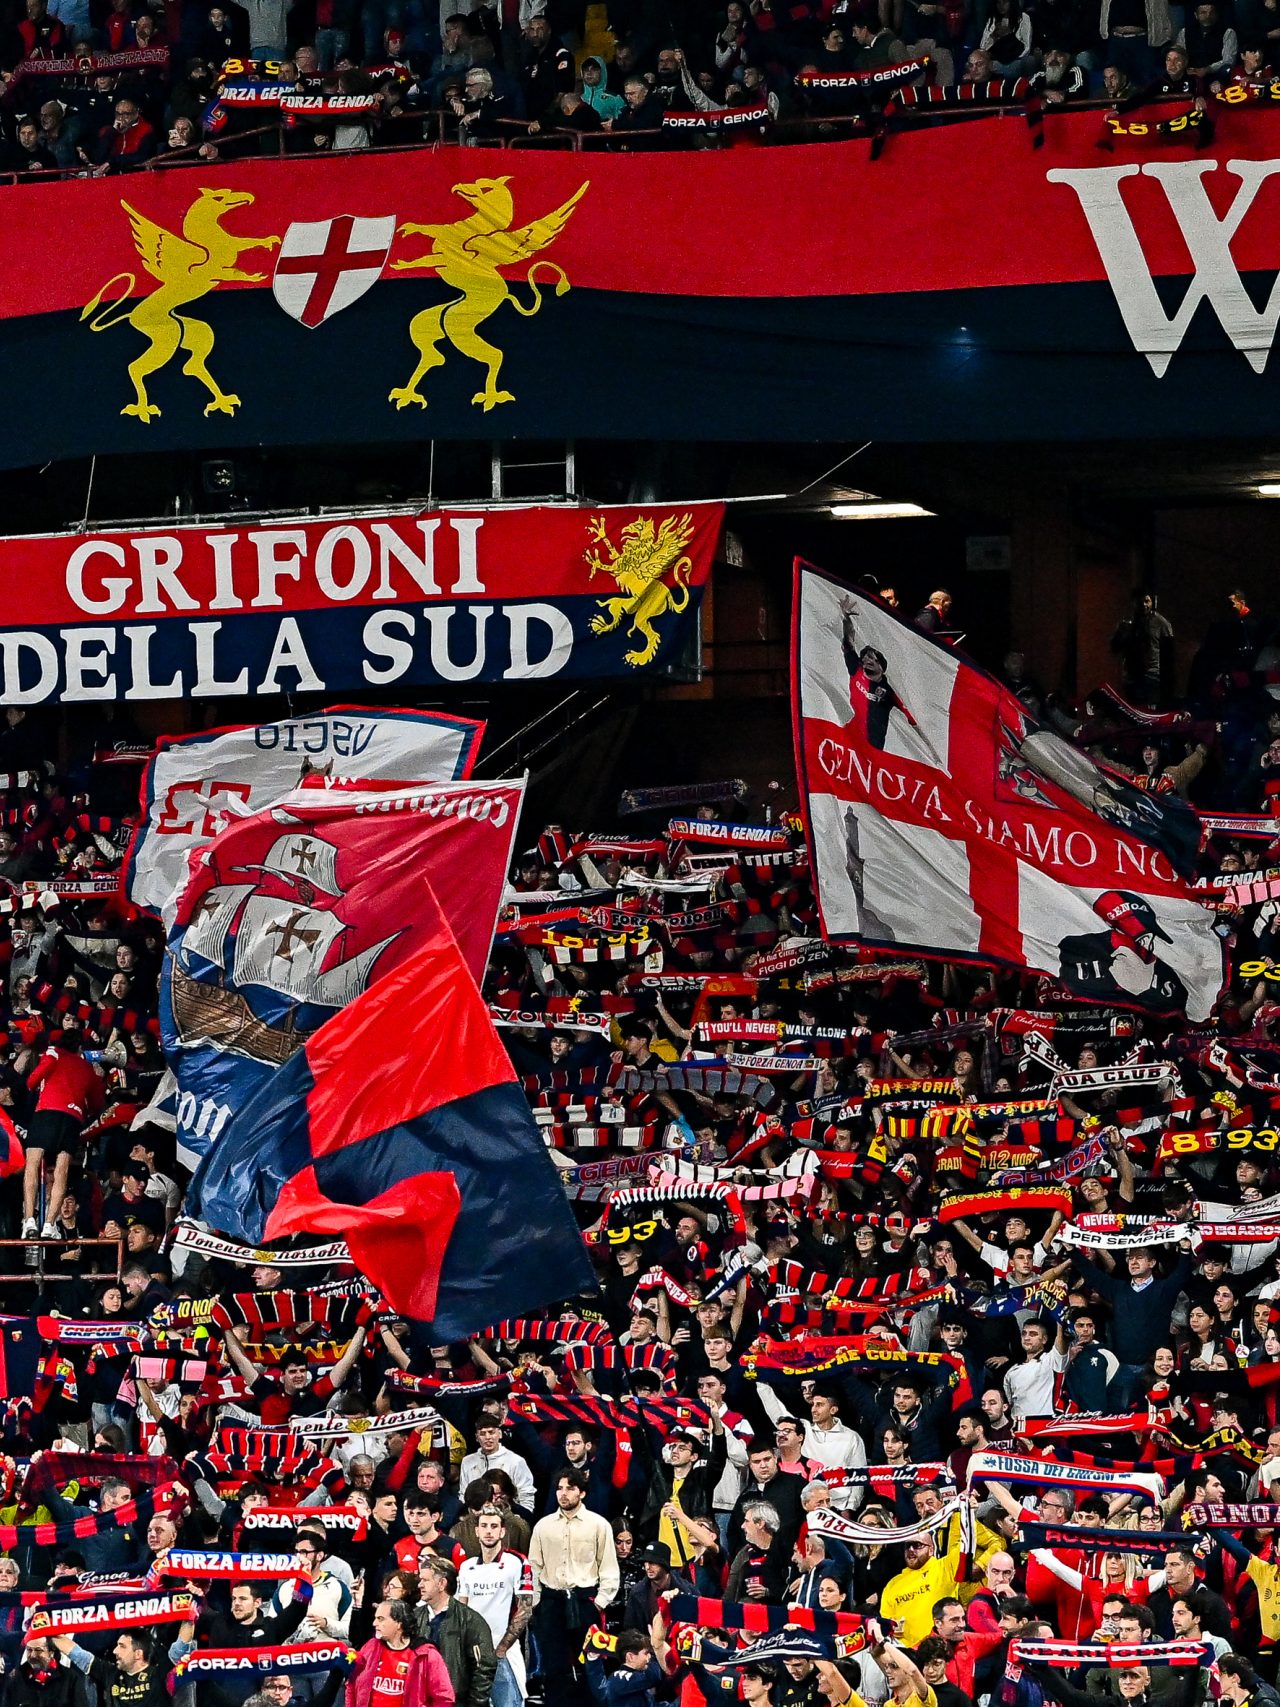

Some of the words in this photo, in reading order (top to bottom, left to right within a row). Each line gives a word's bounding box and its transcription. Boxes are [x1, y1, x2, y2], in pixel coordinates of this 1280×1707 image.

[811, 76, 858, 88] FORZA
[873, 63, 921, 84] GENOA
[280, 94, 322, 108] FORZA
[327, 93, 375, 107] GENOA
[663, 116, 706, 128] FORZA
[721, 108, 768, 125] GENOA
[64, 516, 487, 618] GRIFONI
[361, 600, 575, 686] SUD
[689, 822, 729, 839] FORZA
[731, 826, 771, 842] GENOA
[963, 799, 1098, 868] SIAMO
[46, 882, 82, 893] FORZA
[1211, 872, 1262, 889] GENOA
[1106, 902, 1148, 921] GENOA
[758, 960, 787, 977] FIGGI
[789, 956, 805, 968] DO
[710, 1021, 743, 1035] YOU'LL
[745, 1022, 776, 1035] NEVER
[786, 1025, 814, 1037] WALK
[816, 1027, 847, 1039] ALONE
[744, 1054, 771, 1068] FORZA
[774, 1056, 804, 1070] GENOA
[1102, 1066, 1161, 1084] CLUB
[1156, 1133, 1200, 1158] 18
[1226, 1129, 1279, 1152] 93
[989, 1149, 1010, 1170] 12
[1082, 1214, 1116, 1227] NEVER
[1125, 1214, 1155, 1226] WALK
[606, 1220, 658, 1245] 93
[1070, 1232, 1104, 1244] PER
[1105, 1230, 1176, 1247] SEMPRE
[183, 1230, 251, 1257] Ponente
[178, 1301, 191, 1319] IO
[916, 1351, 944, 1366] TE
[998, 1456, 1040, 1476] FOSSA
[839, 1473, 869, 1487] ghe
[171, 1550, 234, 1570] FORZA
[240, 1554, 300, 1573] GENOA
[78, 1570, 131, 1587] Genoa
[51, 1604, 109, 1627] FORZA
[114, 1598, 171, 1620] GENOA
[187, 1657, 252, 1672] FORZA
[276, 1647, 341, 1667] GENOA
